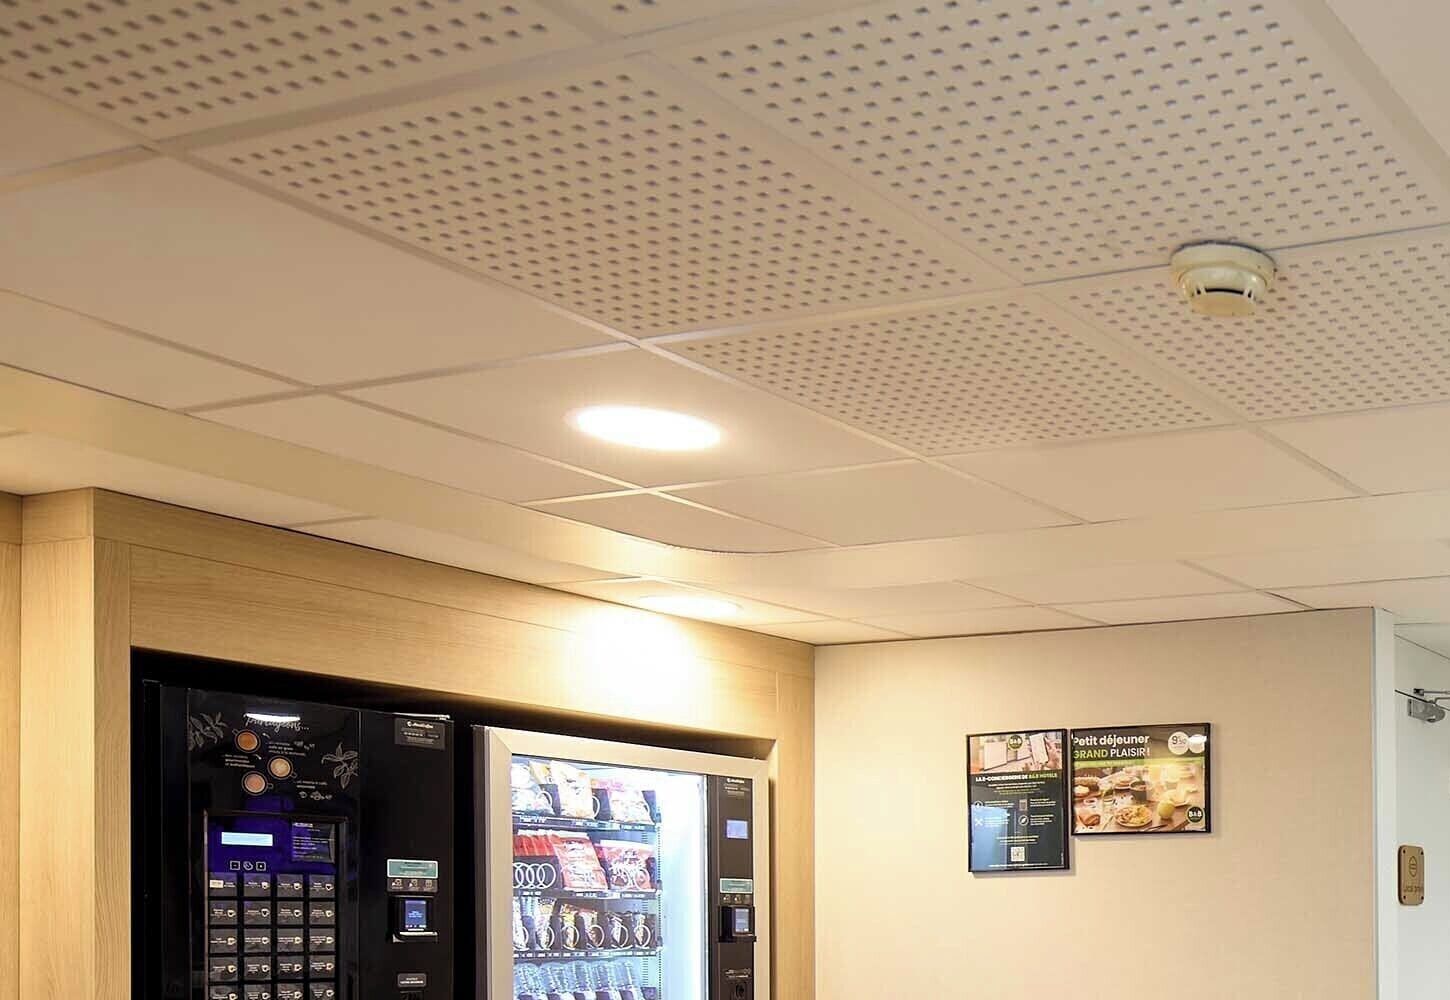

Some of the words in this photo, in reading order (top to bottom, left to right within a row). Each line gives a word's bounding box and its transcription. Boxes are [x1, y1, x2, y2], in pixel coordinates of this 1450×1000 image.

[1072, 735, 1098, 747] Petit
[1100, 734, 1150, 747] déjeuner
[1073, 749, 1108, 759] GRAND
